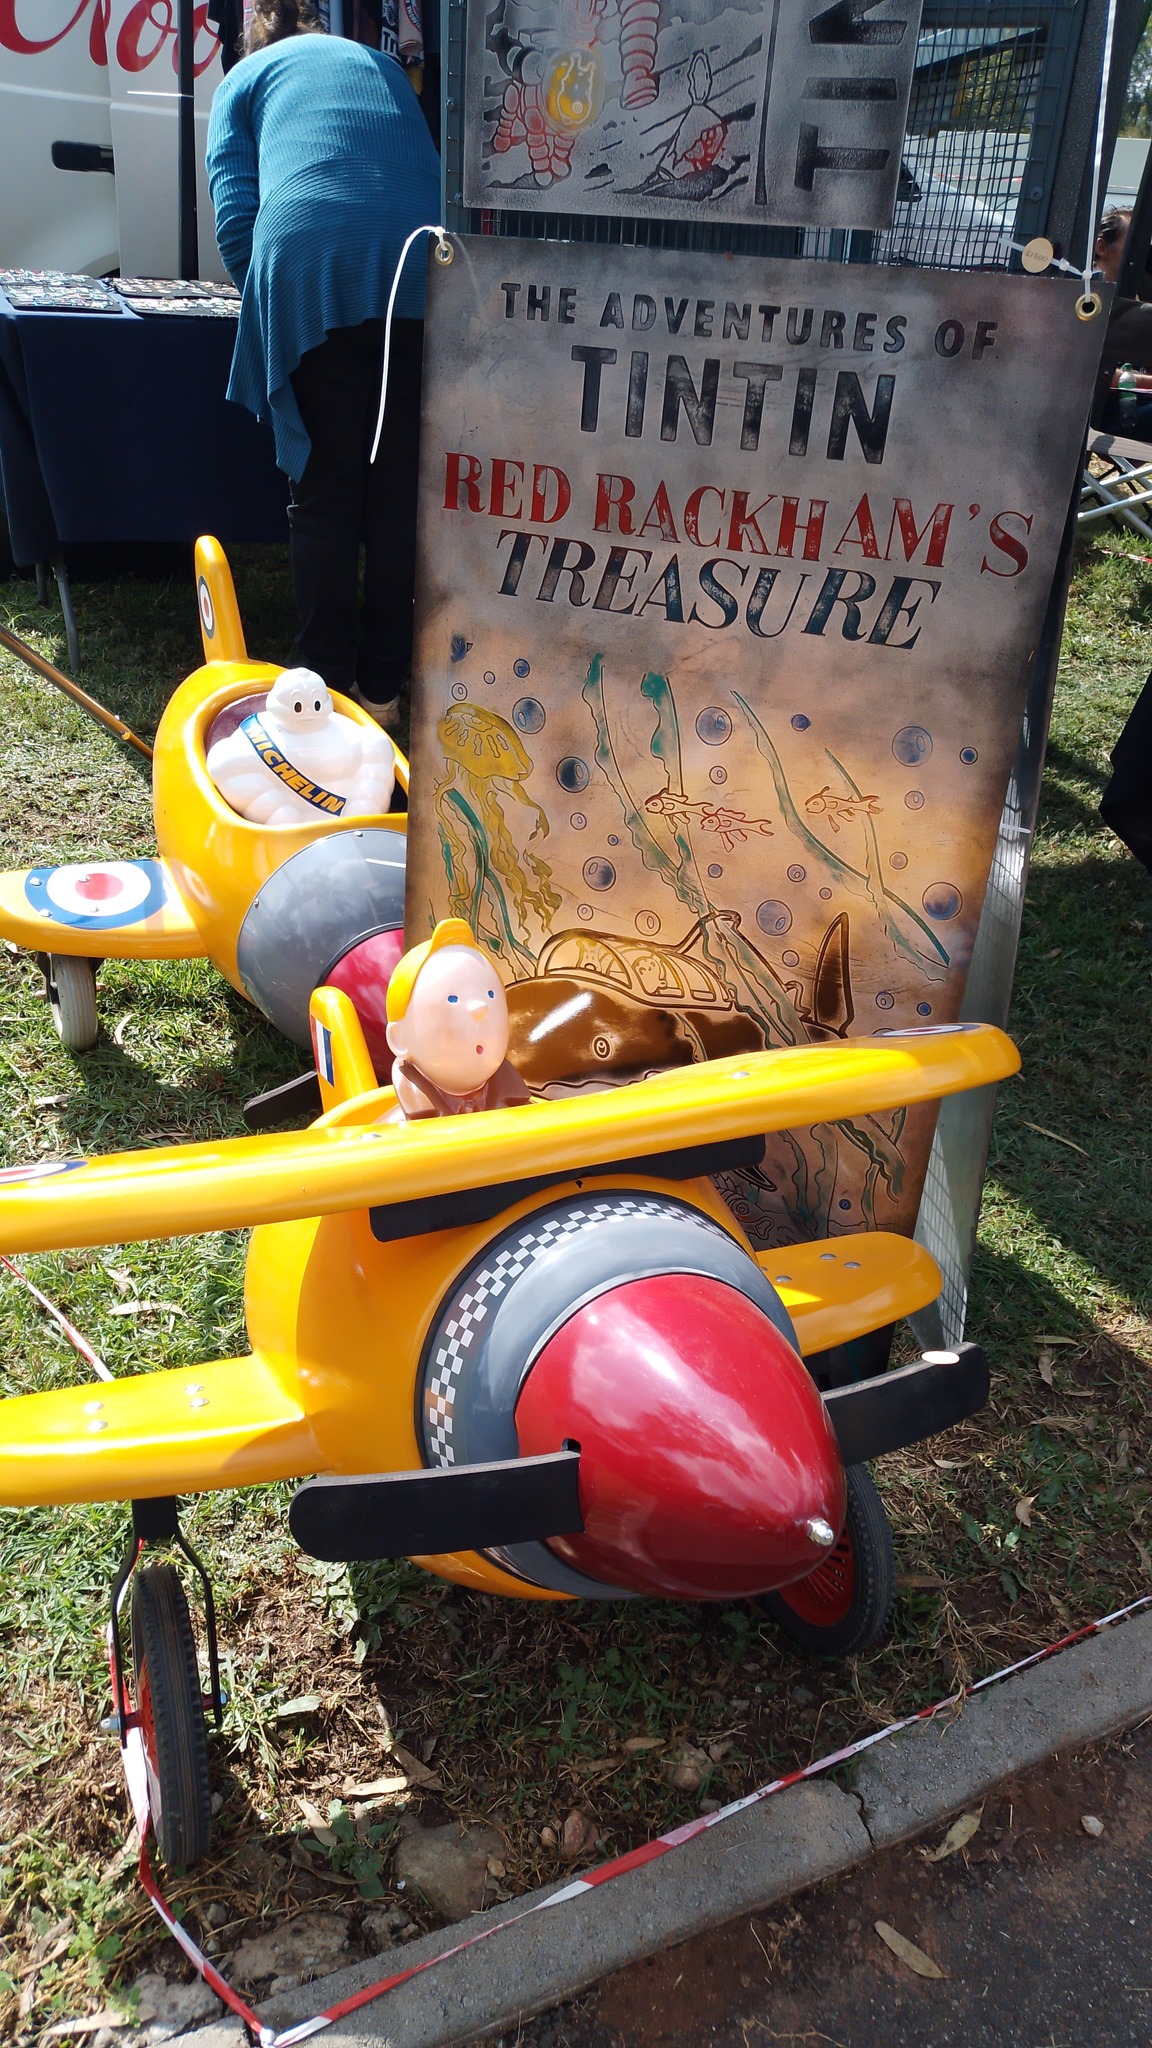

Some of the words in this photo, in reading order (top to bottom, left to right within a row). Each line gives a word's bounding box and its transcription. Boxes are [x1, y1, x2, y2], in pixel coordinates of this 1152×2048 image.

[501, 282, 577, 324] THE
[600, 292, 908, 354] ADVENTURES
[934, 318, 999, 360] OF
[570, 344, 897, 465] TINTIN
[442, 451, 572, 524] RED
[592, 472, 1035, 578] RACKHAM'S
[496, 528, 943, 650] TREASURE
[245, 724, 345, 813] MICHELIN
